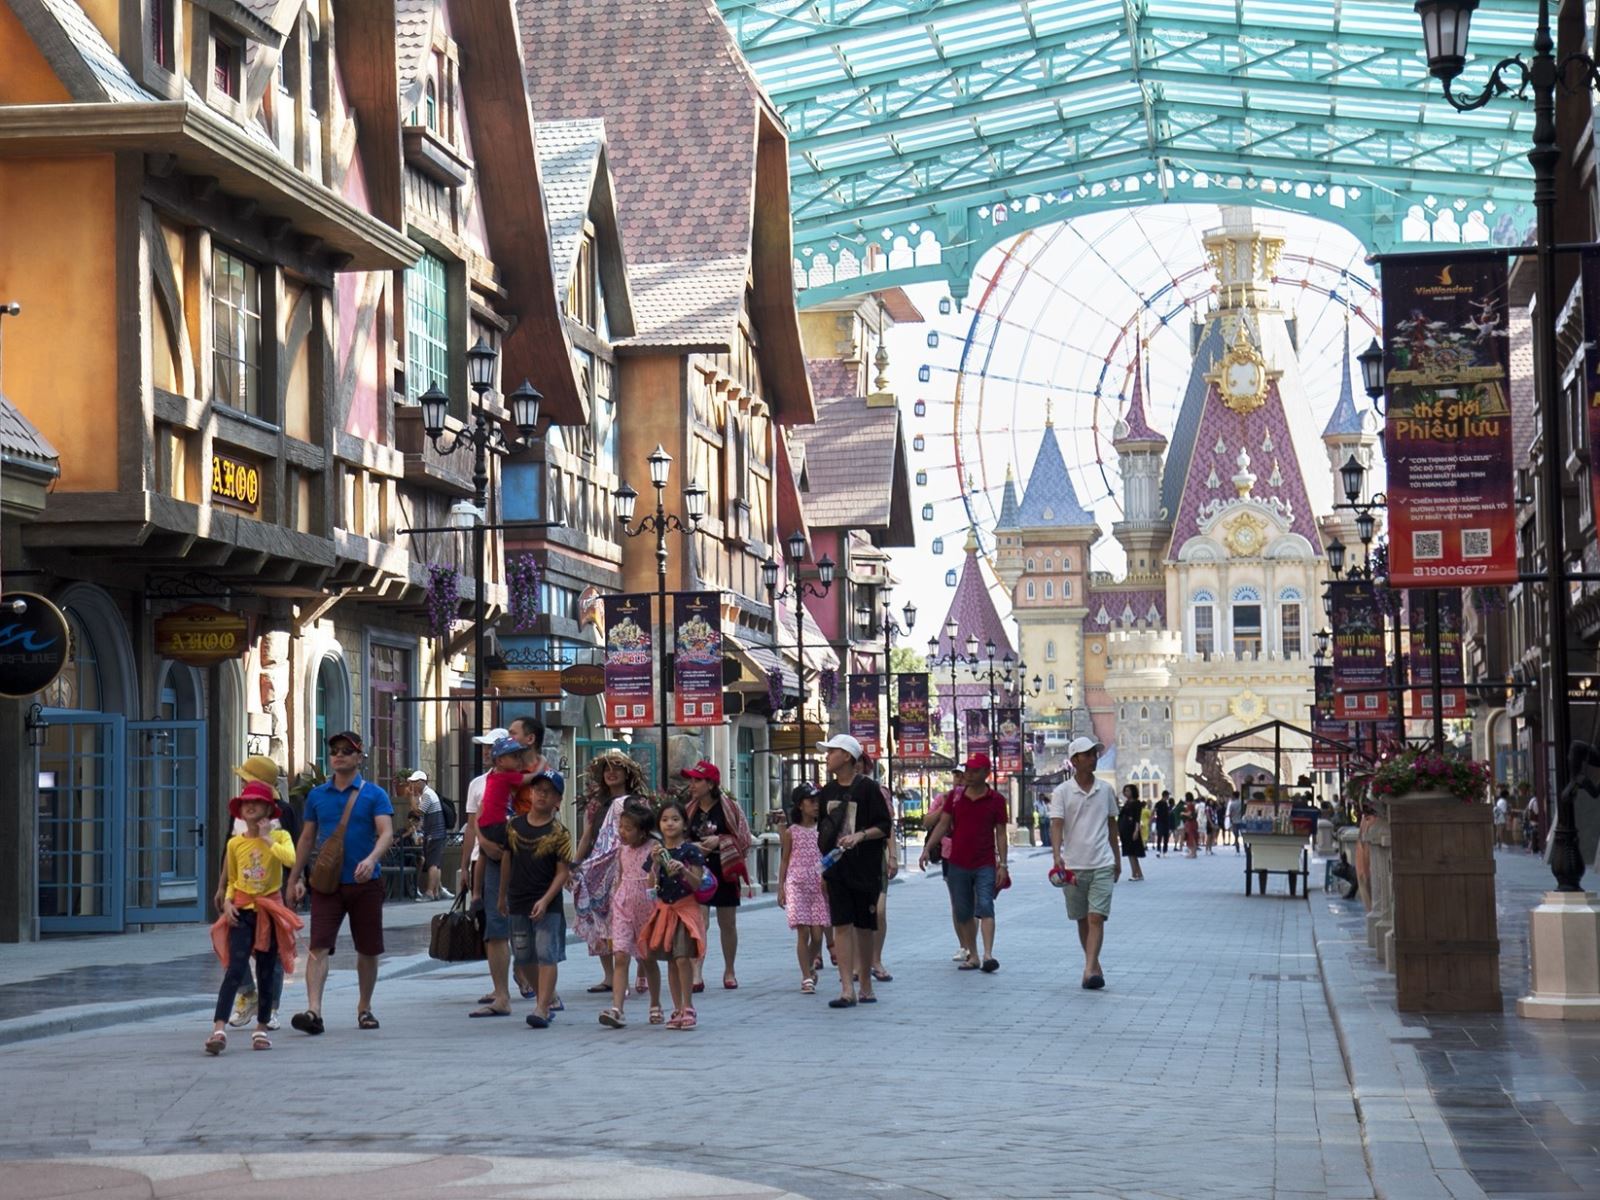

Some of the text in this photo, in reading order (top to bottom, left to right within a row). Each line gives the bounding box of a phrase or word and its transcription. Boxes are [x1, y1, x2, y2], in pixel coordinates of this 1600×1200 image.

[1415, 286, 1473, 295] VinWonders
[1413, 400, 1480, 419] thế giới
[1396, 416, 1499, 440] Phiêu lưu
[1425, 565, 1488, 576] 19006677
